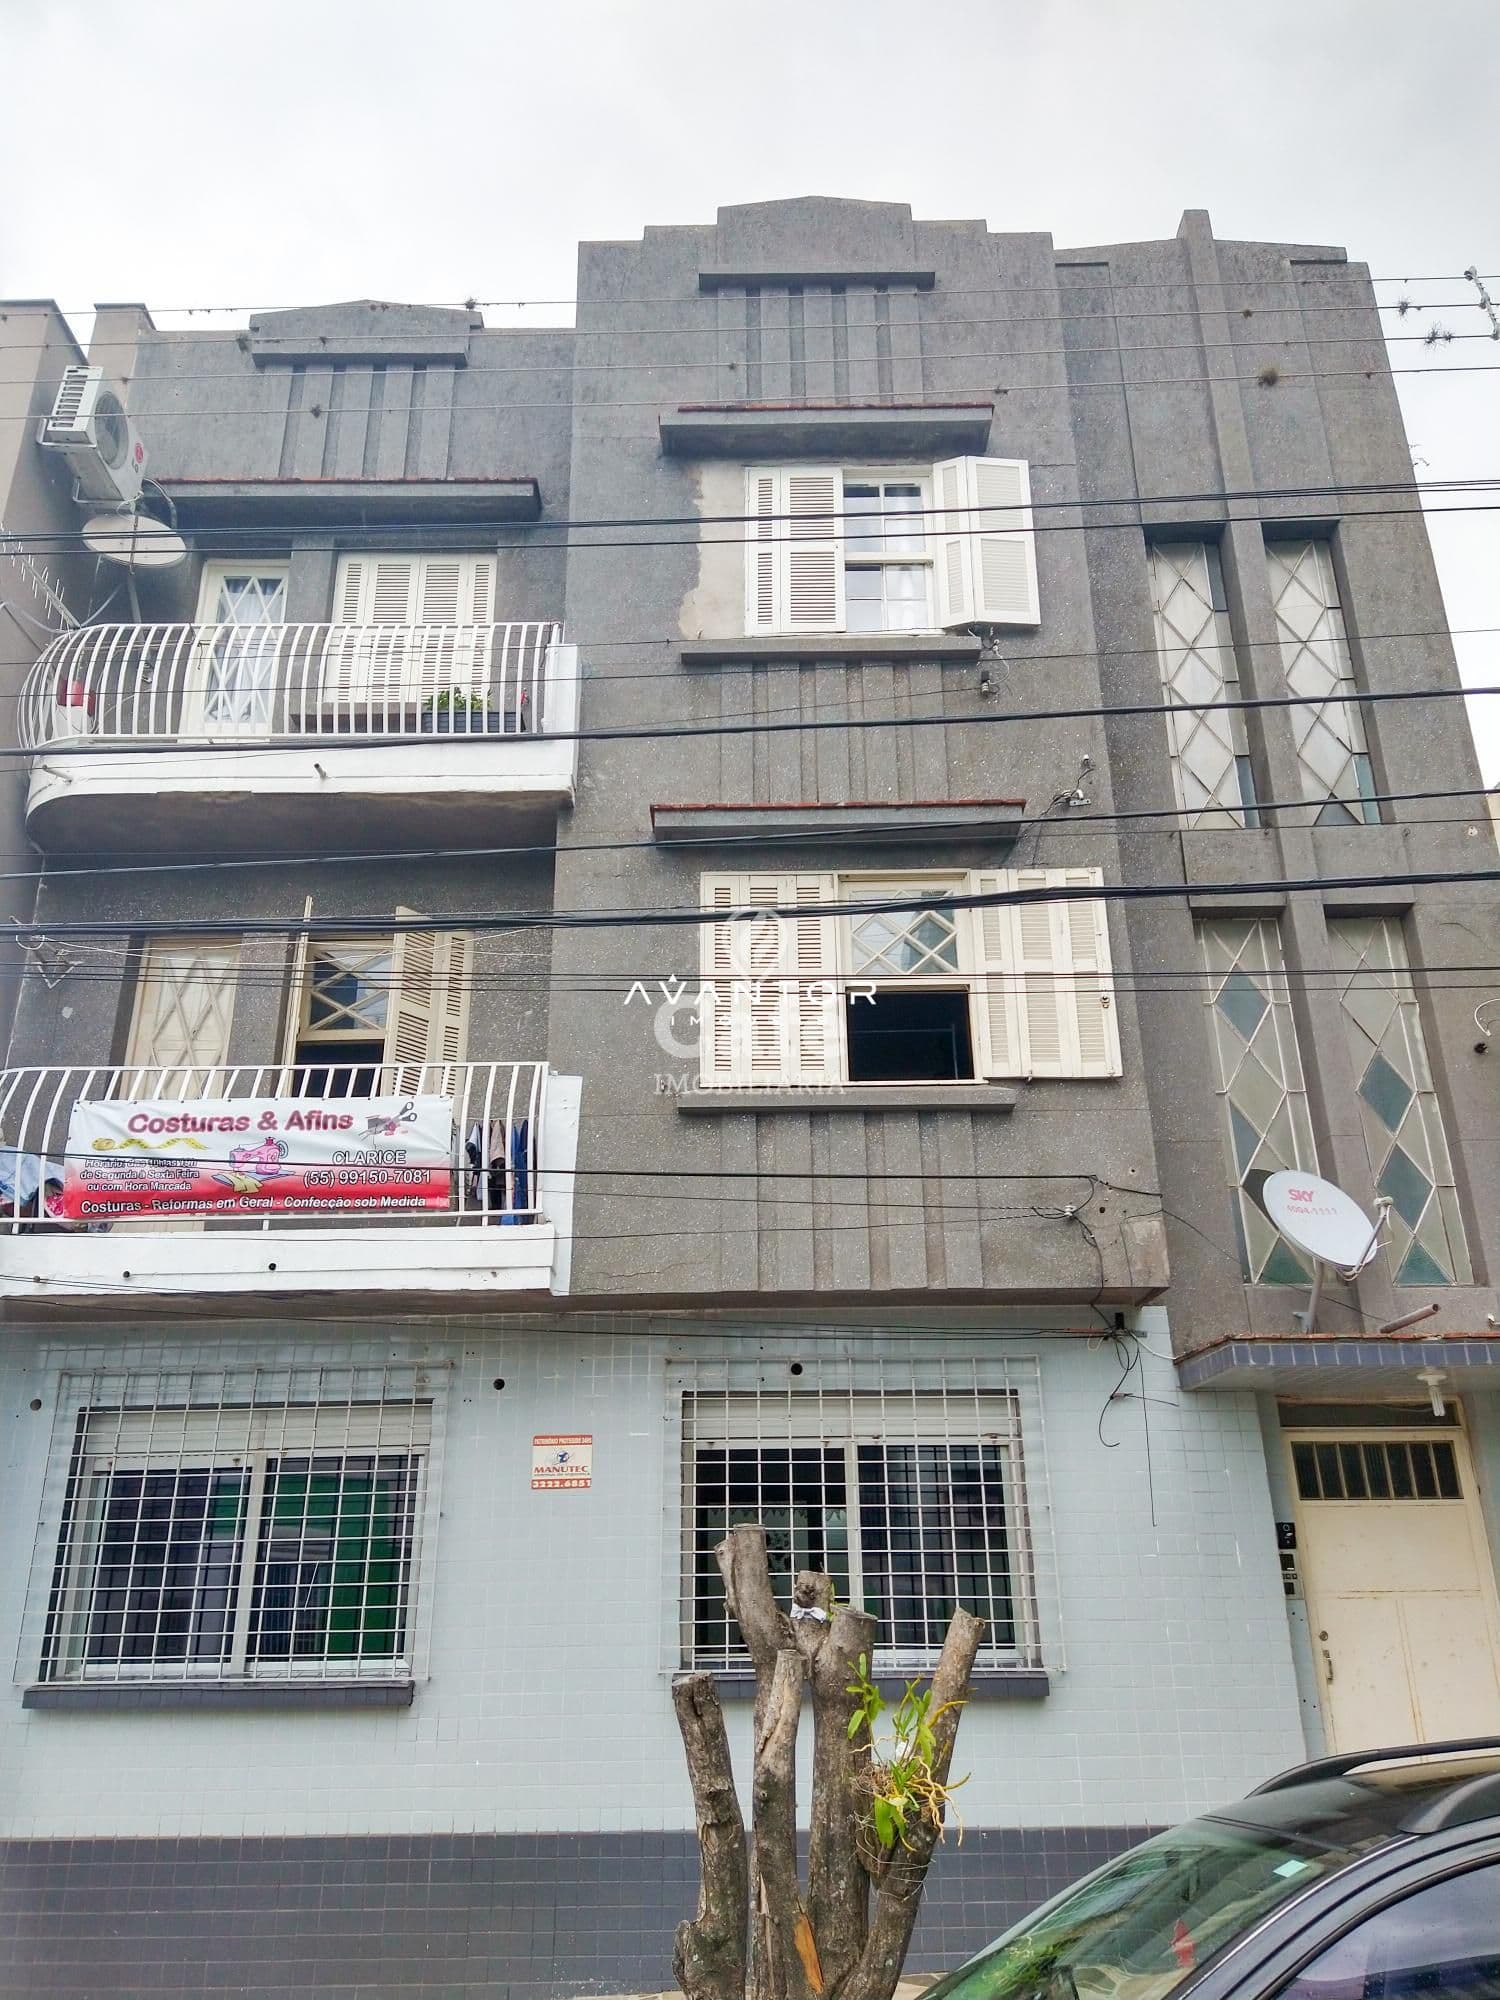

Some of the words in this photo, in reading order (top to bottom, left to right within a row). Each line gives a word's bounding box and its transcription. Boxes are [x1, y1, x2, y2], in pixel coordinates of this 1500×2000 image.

[127, 1112, 251, 1134] Costuras
[257, 1110, 278, 1132] &
[284, 1109, 354, 1132] Afins
[332, 1150, 407, 1165] CLARICE
[80, 1170, 93, 1179] de
[95, 1171, 137, 1181] Segunda
[147, 1171, 175, 1179] Sexta
[176, 1169, 199, 1178] Feira
[304, 1170, 335, 1188] (55)
[338, 1169, 432, 1185] 99150-7081
[87, 1183, 99, 1191] ou
[101, 1183, 123, 1191] com
[125, 1182, 148, 1191] Hora
[150, 1181, 192, 1191] Marcada
[1288, 1188, 1313, 1202] SKY
[81, 1200, 141, 1213] Costuras
[151, 1199, 213, 1211] Reformas
[216, 1199, 236, 1209] em
[239, 1197, 273, 1209] Geral
[284, 1195, 351, 1209] Confecção
[354, 1197, 377, 1207] sob
[380, 1196, 426, 1207] Medida
